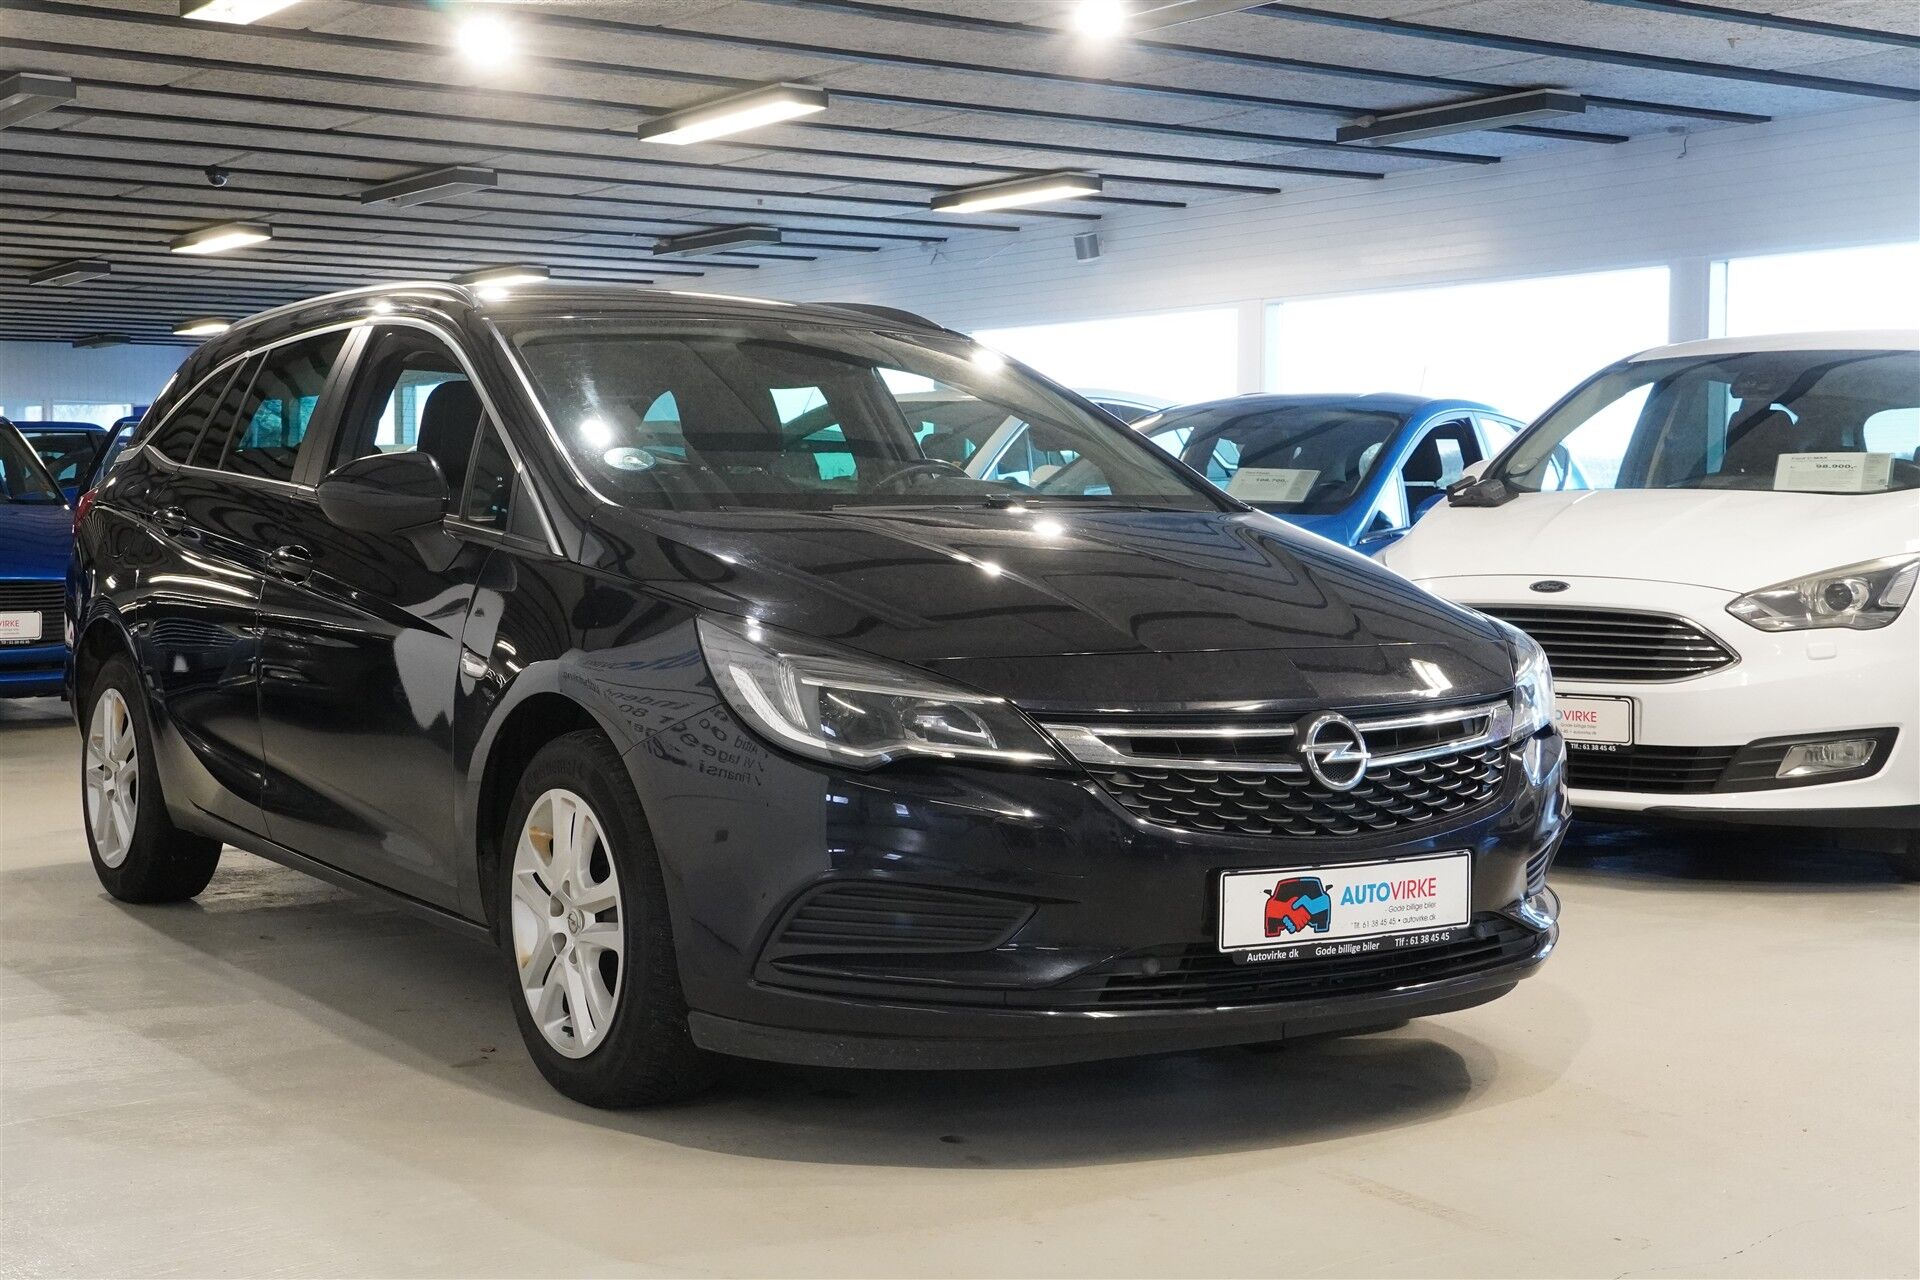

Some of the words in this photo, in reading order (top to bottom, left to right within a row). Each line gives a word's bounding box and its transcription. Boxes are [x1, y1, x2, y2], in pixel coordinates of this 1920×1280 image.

[1340, 877, 1437, 906] AUTOVIRKE
[1362, 920, 1370, 928] 61
[1409, 936, 1419, 946] 61
[1420, 934, 1430, 945] 38
[1430, 933, 1440, 943] 45
[1440, 931, 1450, 942] 45
[1315, 945, 1337, 956] Gode
[1337, 943, 1361, 955] billige
[1362, 941, 1380, 951] biler
